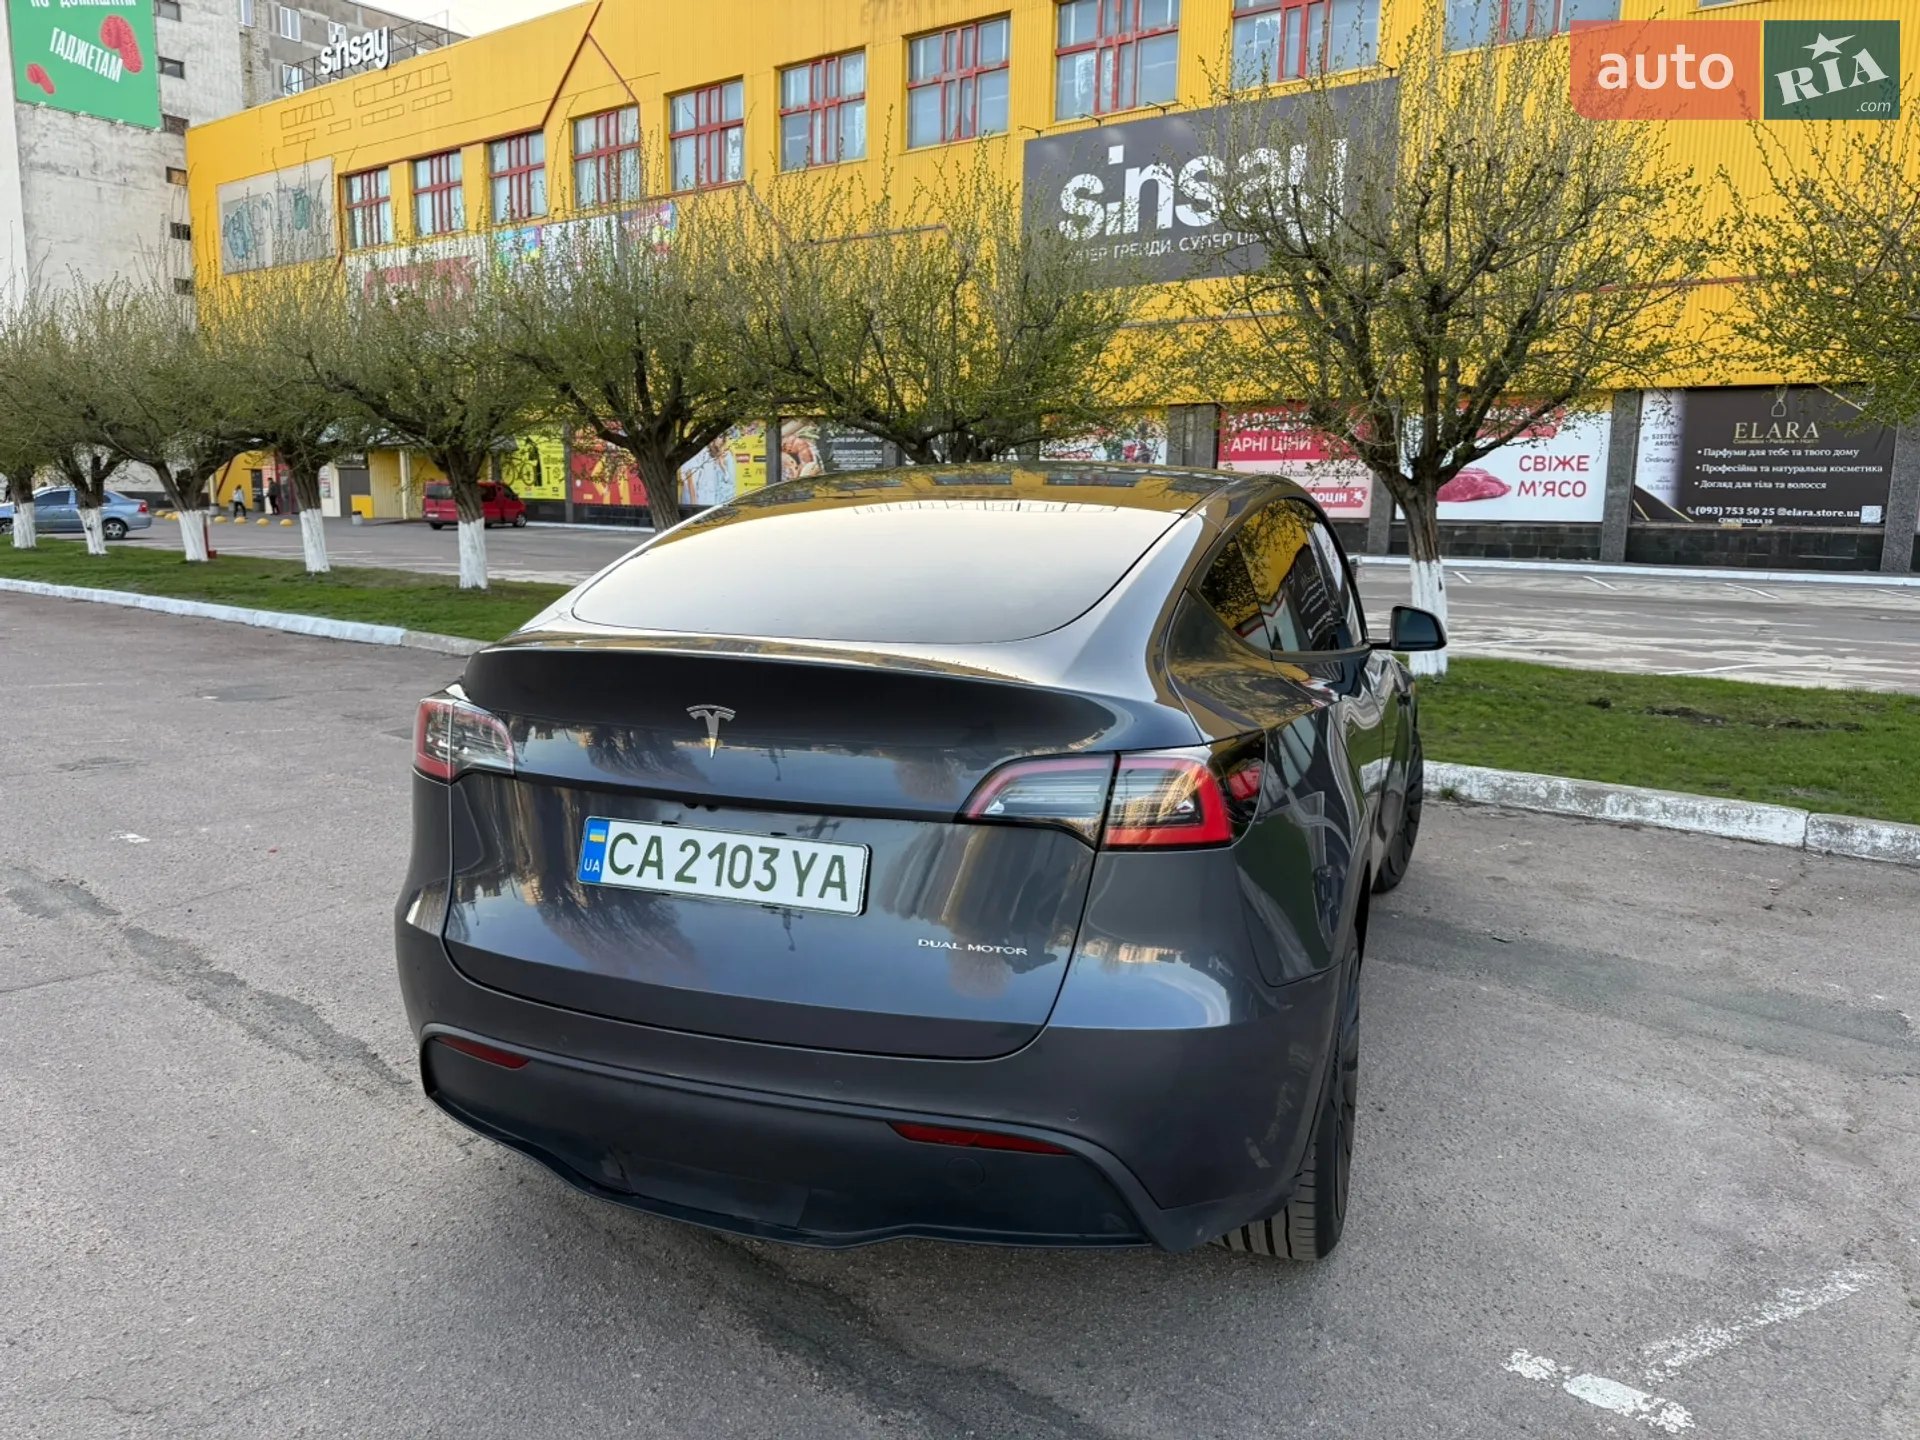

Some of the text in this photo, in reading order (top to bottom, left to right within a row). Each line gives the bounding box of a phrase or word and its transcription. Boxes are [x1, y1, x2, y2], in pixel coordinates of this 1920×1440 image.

[50, 27, 123, 83] ГАДЖЕТАМ
[320, 26, 390, 74] sinsay
[1059, 138, 1348, 244] sinsay
[1734, 421, 1819, 439] ELARA
[1224, 436, 1268, 453] АРНІ
[1703, 448, 1747, 458] Парфуми
[1748, 449, 1766, 457] для
[1768, 448, 1790, 456] тебе
[1832, 449, 1860, 459] дому
[1519, 455, 1590, 472] СВІЖЕ
[1701, 464, 1758, 474] Професійна
[1772, 465, 1827, 475] натуральна
[1829, 465, 1883, 473] косметика
[1699, 480, 1733, 489] Догляд
[1734, 481, 1753, 489] для
[1754, 480, 1773, 488] тіла
[1787, 481, 1827, 489] волосся
[1695, 506, 1723, 516] (093)
[1725, 506, 1744, 515] 753
[1746, 507, 1760, 515] 50
[1761, 507, 1775, 516] 25
[584, 858, 601, 872] UA
[674, 838, 781, 892] 2103
[918, 939, 1028, 956] DUAL MOTOR
